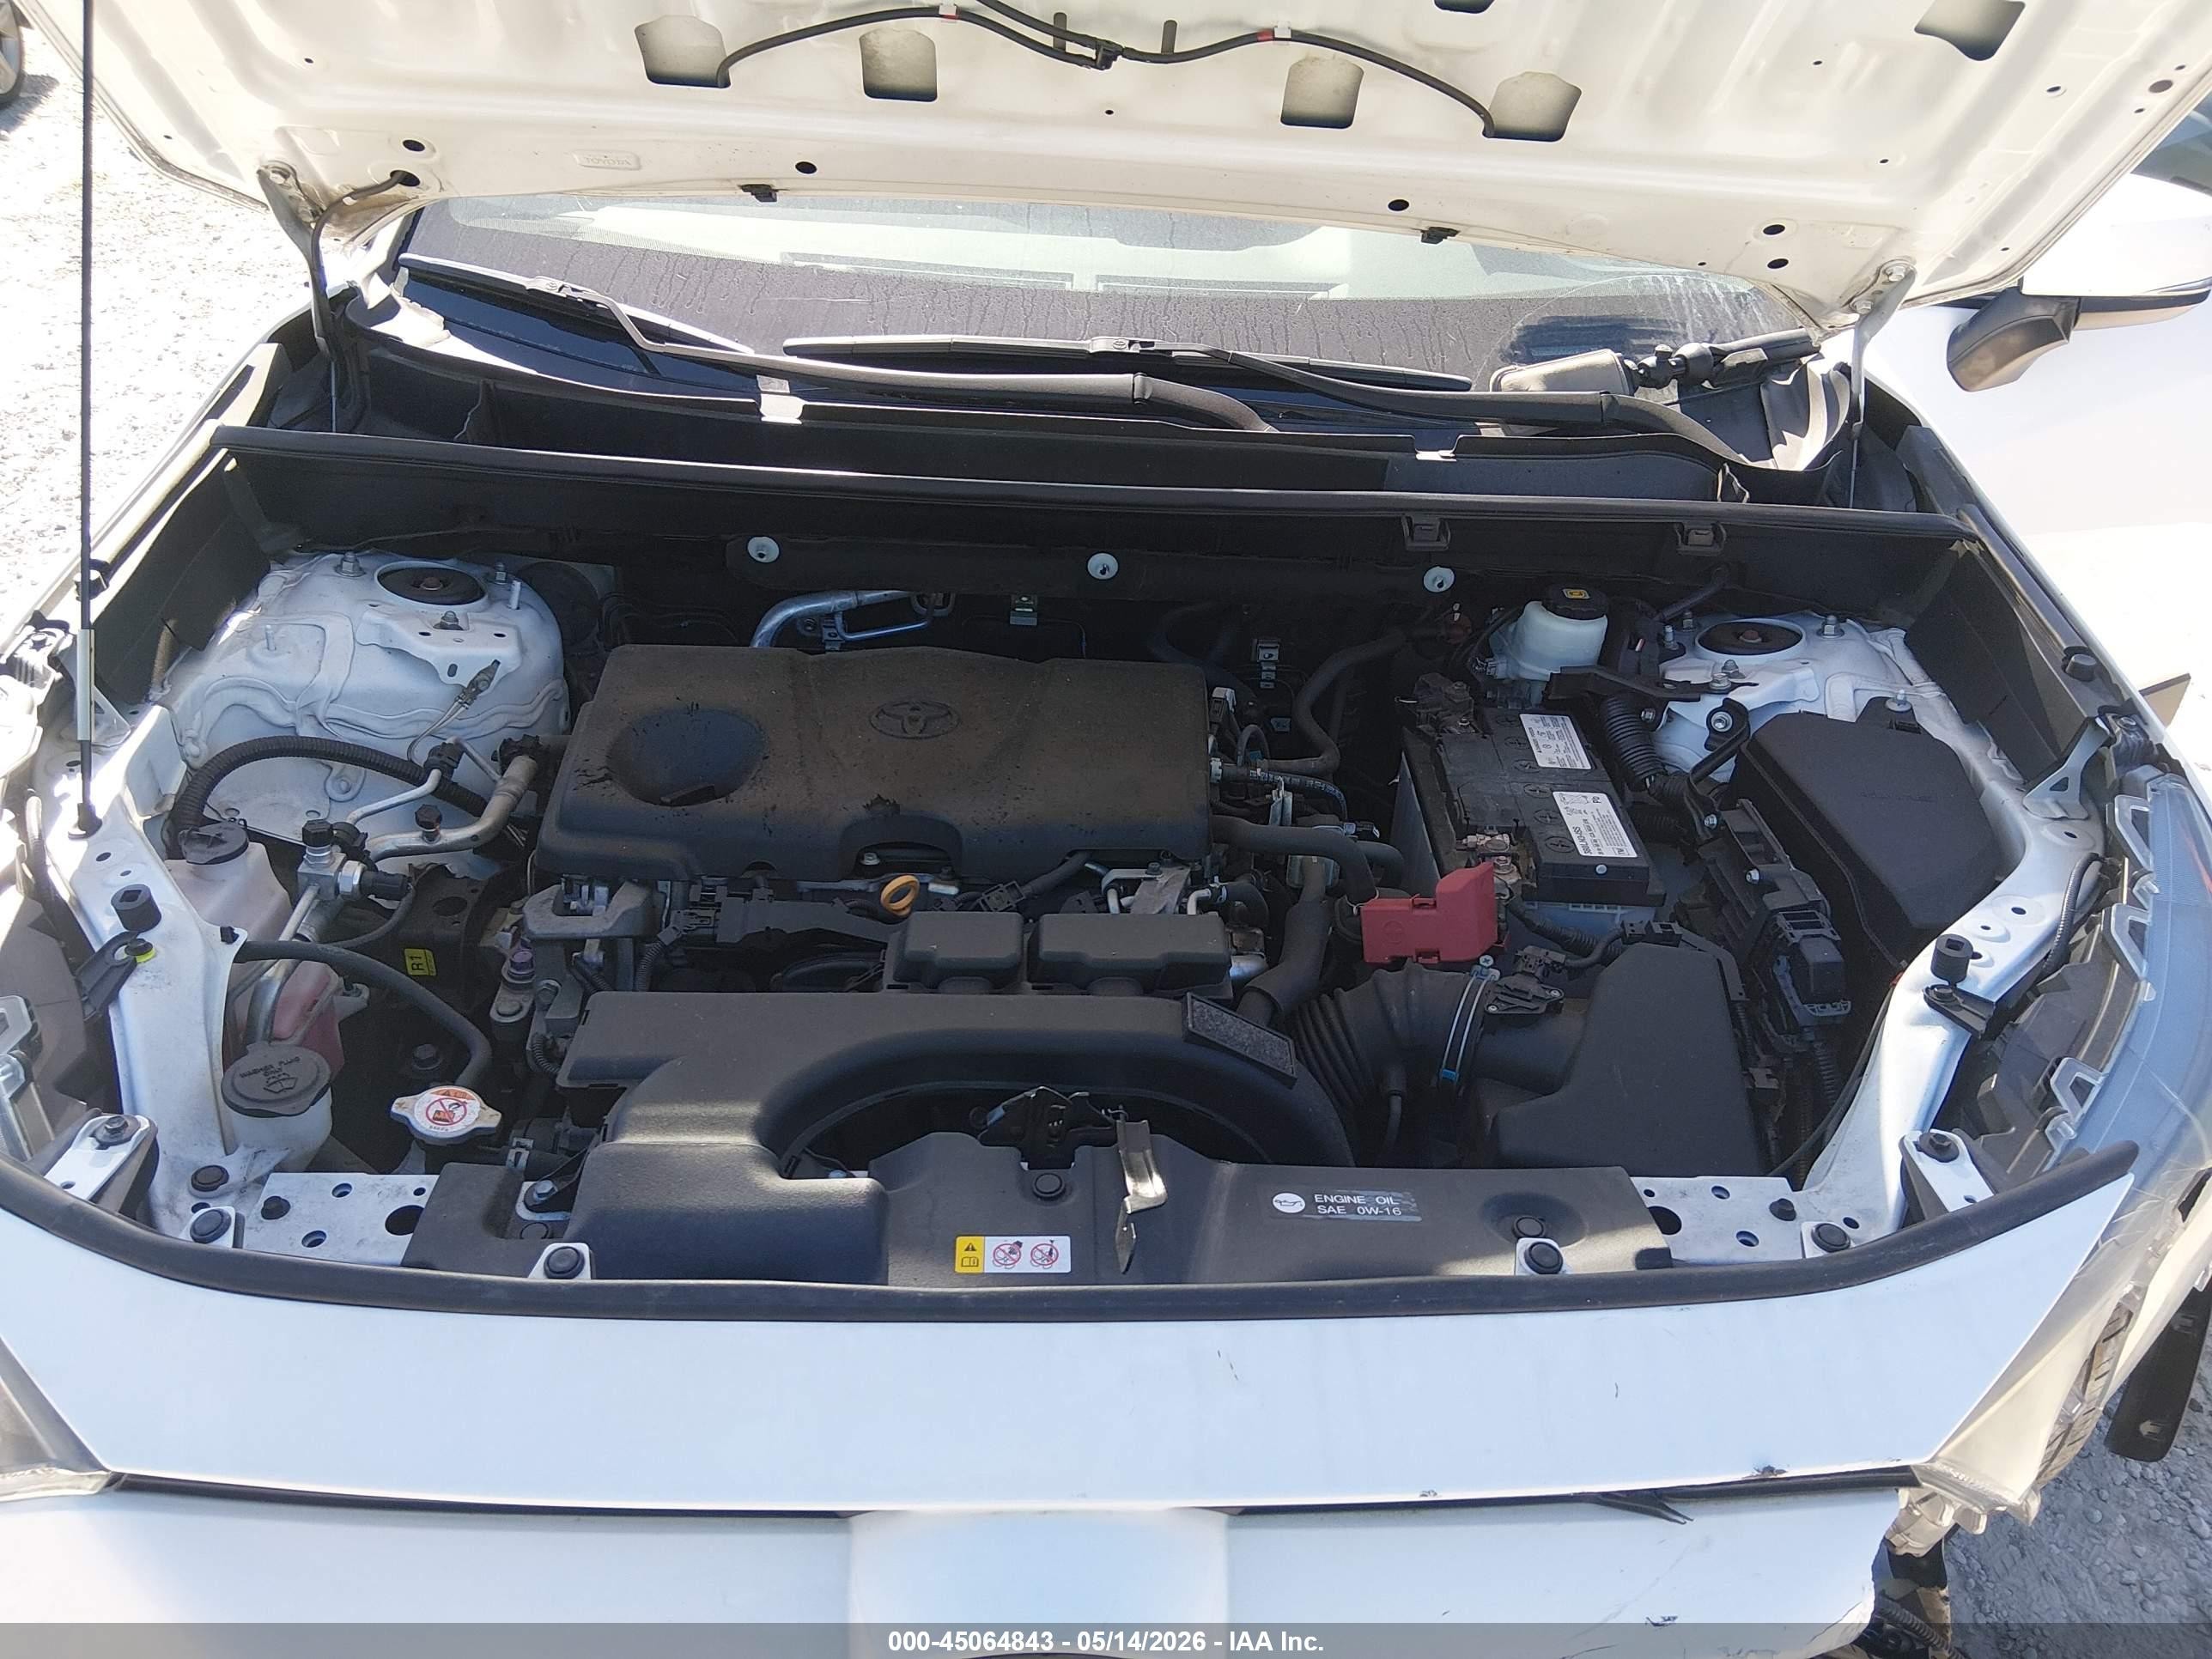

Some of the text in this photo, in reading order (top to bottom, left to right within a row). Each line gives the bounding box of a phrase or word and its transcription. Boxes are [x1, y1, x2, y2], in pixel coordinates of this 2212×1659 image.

[410, 956, 424, 970] R1
[1314, 1194, 1400, 1205] ENGINE OIL
[1317, 1206, 1401, 1216] SAE 0W-16
